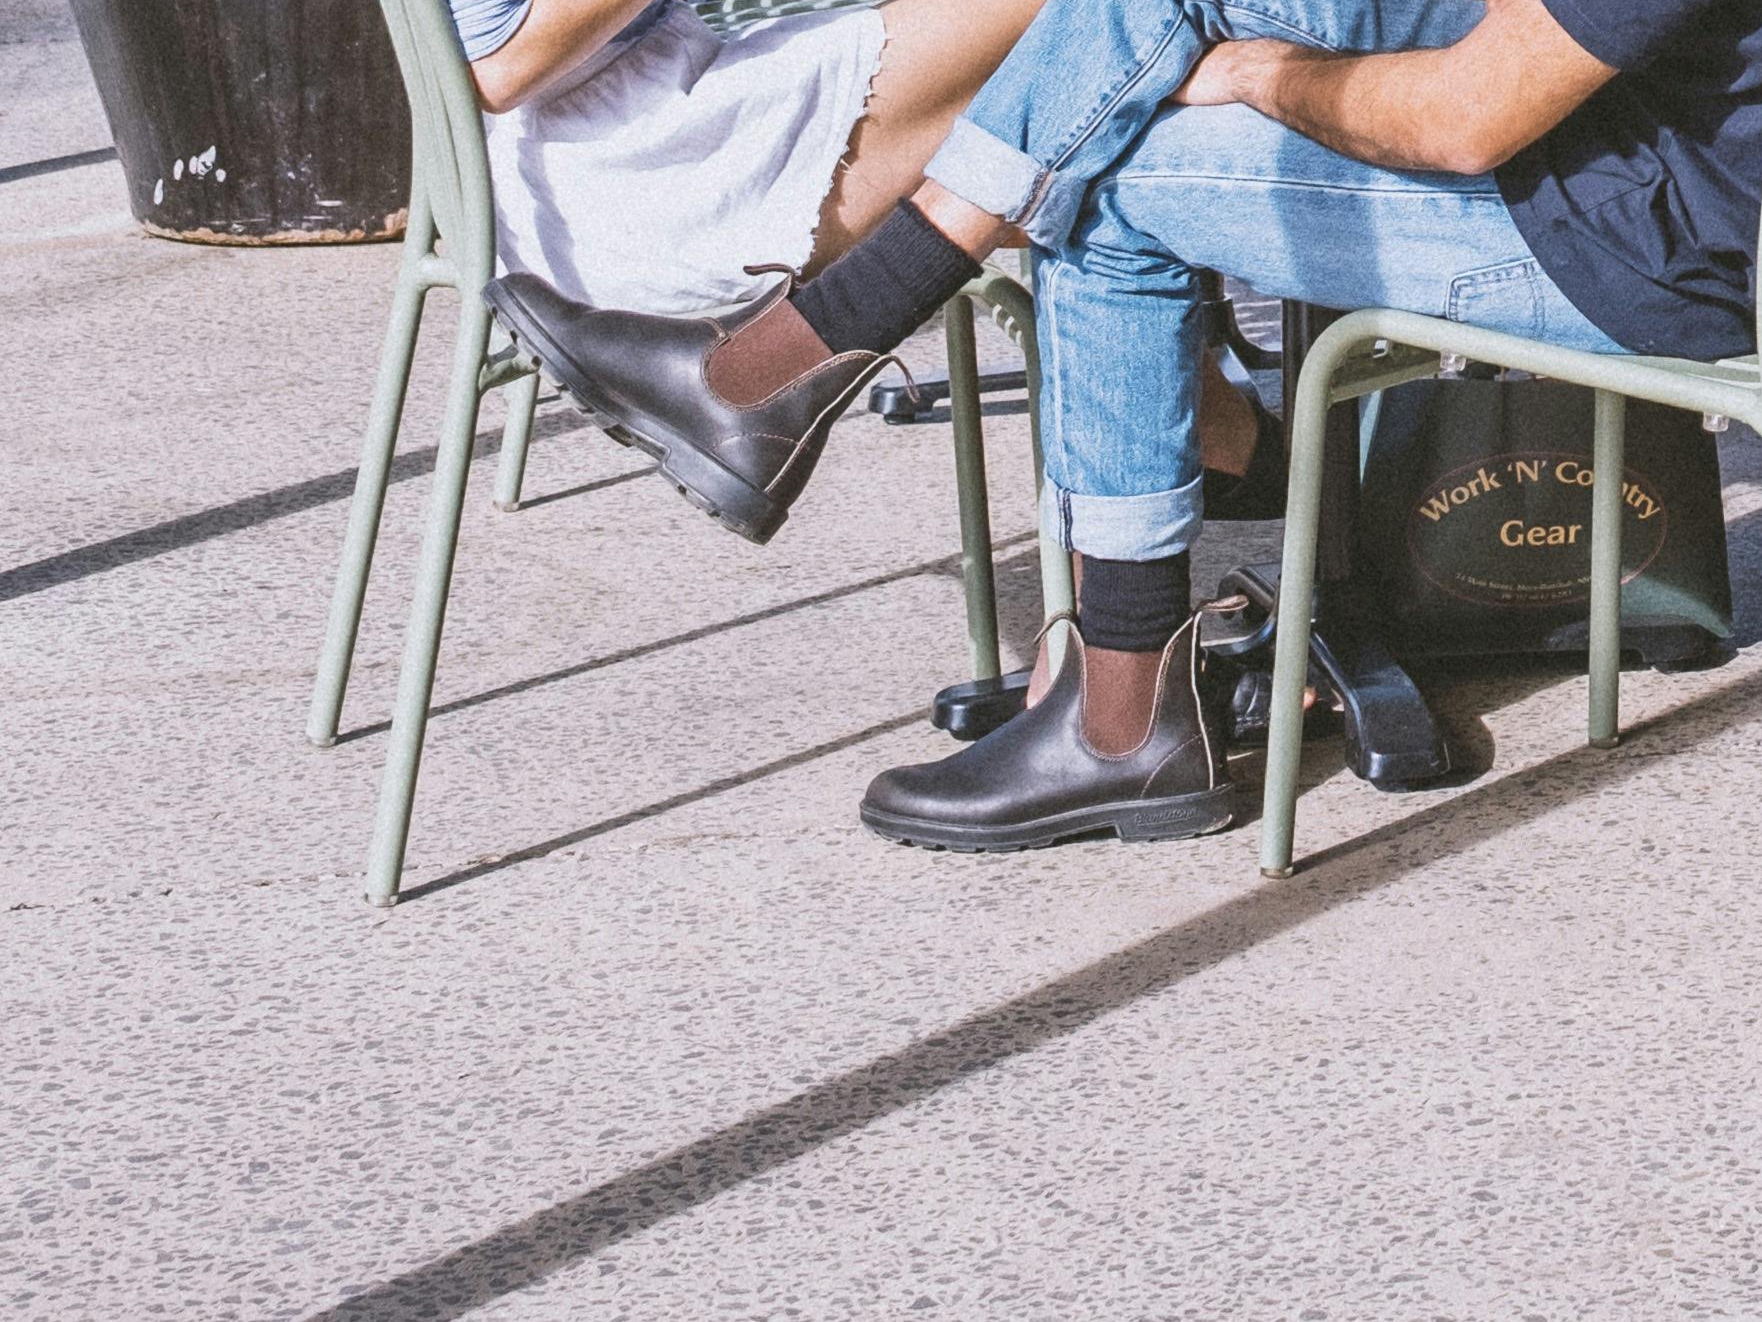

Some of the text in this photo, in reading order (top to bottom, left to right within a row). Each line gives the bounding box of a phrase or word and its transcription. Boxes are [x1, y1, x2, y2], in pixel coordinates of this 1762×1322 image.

[1419, 467, 1502, 522] Work
[1555, 461, 1661, 519] Cotry
[1500, 520, 1582, 547] Gear
